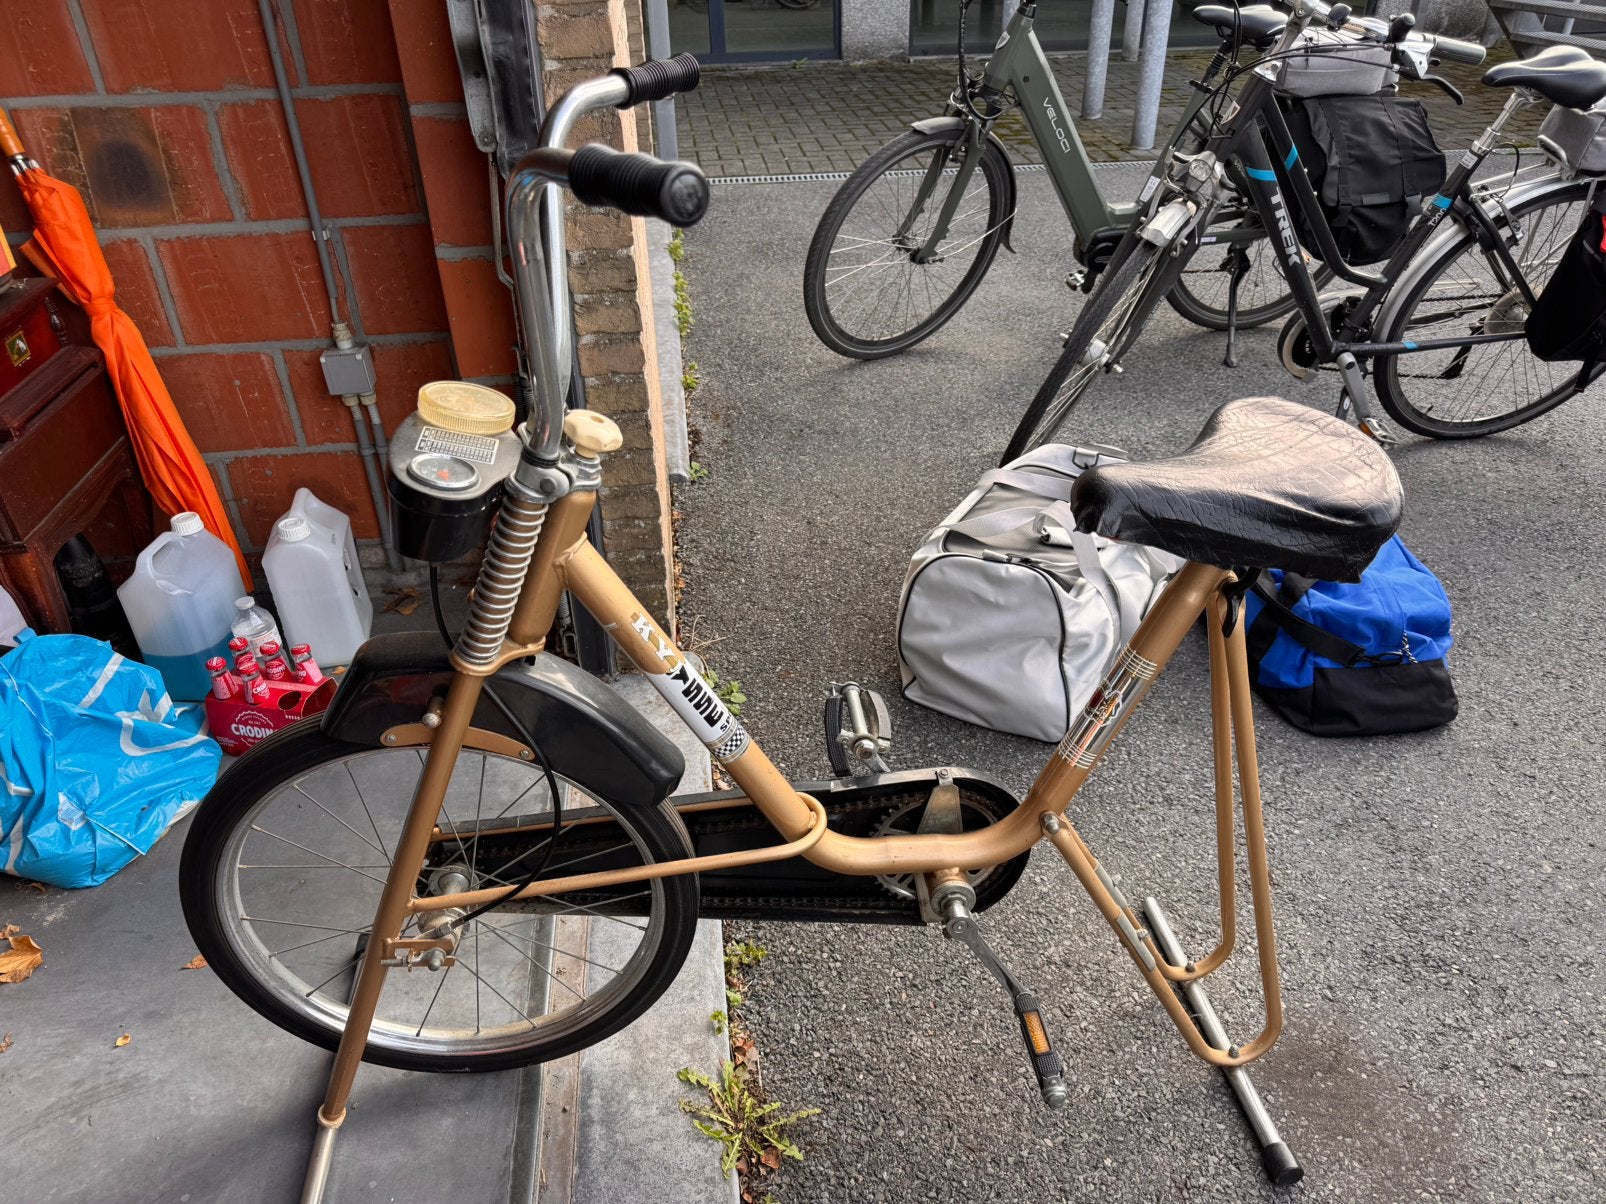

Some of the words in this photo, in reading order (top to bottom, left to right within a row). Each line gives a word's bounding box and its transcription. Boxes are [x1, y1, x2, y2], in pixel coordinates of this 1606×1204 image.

[1043, 96, 1071, 153] VELOCI
[1270, 186, 1302, 267] TREK
[631, 612, 684, 672] KY
[666, 664, 724, 728] YSSE
[231, 723, 278, 739] CRODIN
